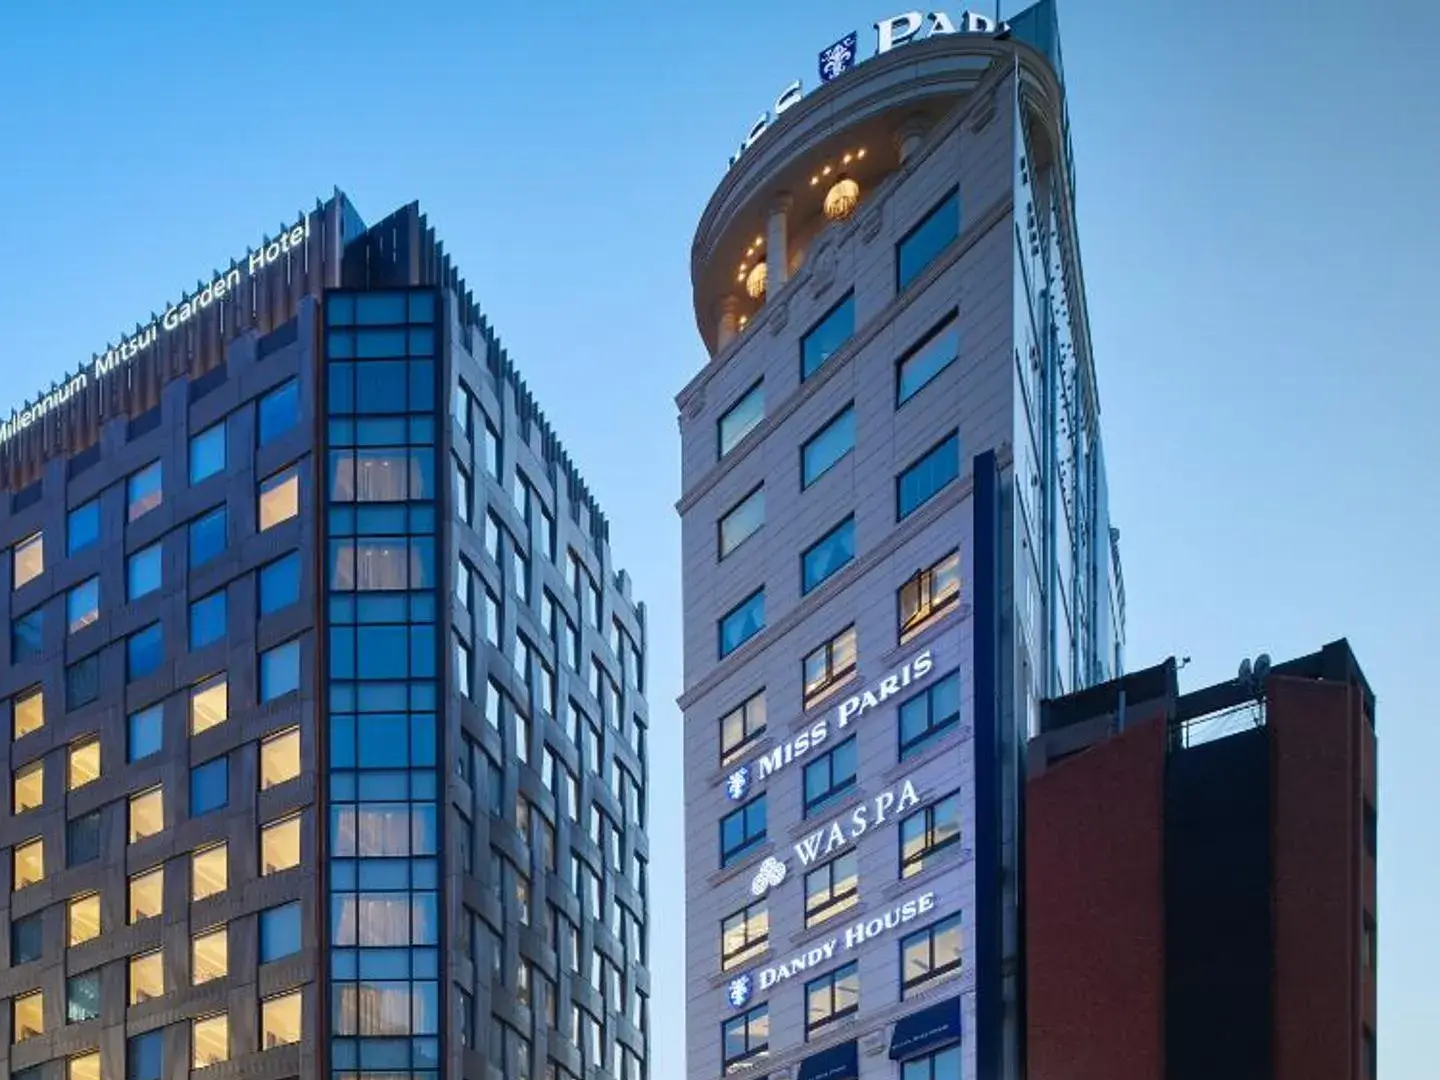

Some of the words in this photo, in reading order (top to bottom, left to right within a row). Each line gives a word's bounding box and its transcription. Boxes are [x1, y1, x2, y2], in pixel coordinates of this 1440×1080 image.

[94, 321, 157, 380] Mitsui
[163, 268, 240, 330] Garden
[249, 213, 310, 275] Hotel
[759, 719, 829, 780] MISS
[838, 650, 934, 729] PARIS
[794, 779, 921, 866] WASPA
[759, 938, 837, 991] DANDY
[845, 891, 936, 950] HOUSE
